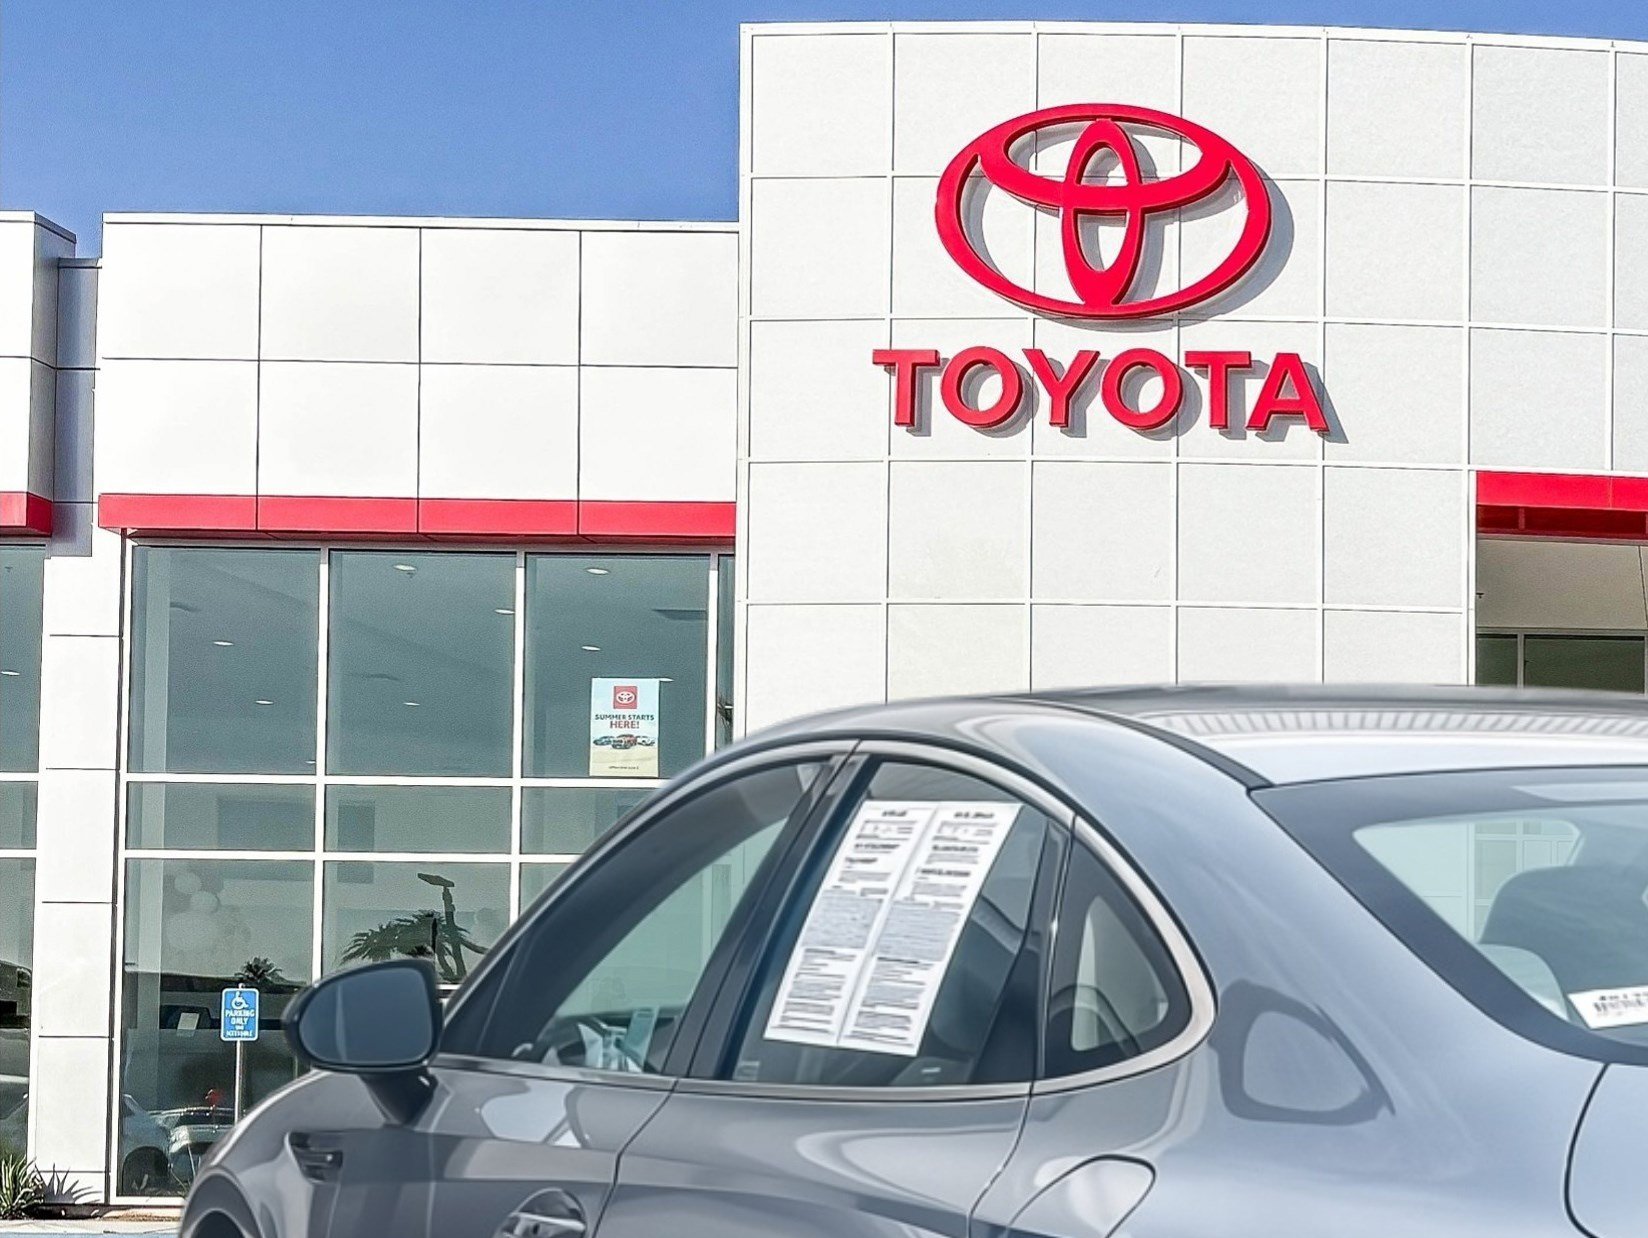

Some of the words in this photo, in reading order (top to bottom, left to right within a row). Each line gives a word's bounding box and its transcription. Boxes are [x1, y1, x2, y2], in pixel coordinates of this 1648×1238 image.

[872, 346, 1331, 433] TOYOTA
[609, 721, 640, 729] HERE!
[225, 1009, 255, 1017] PARKING
[230, 1017, 249, 1025] ONLY
